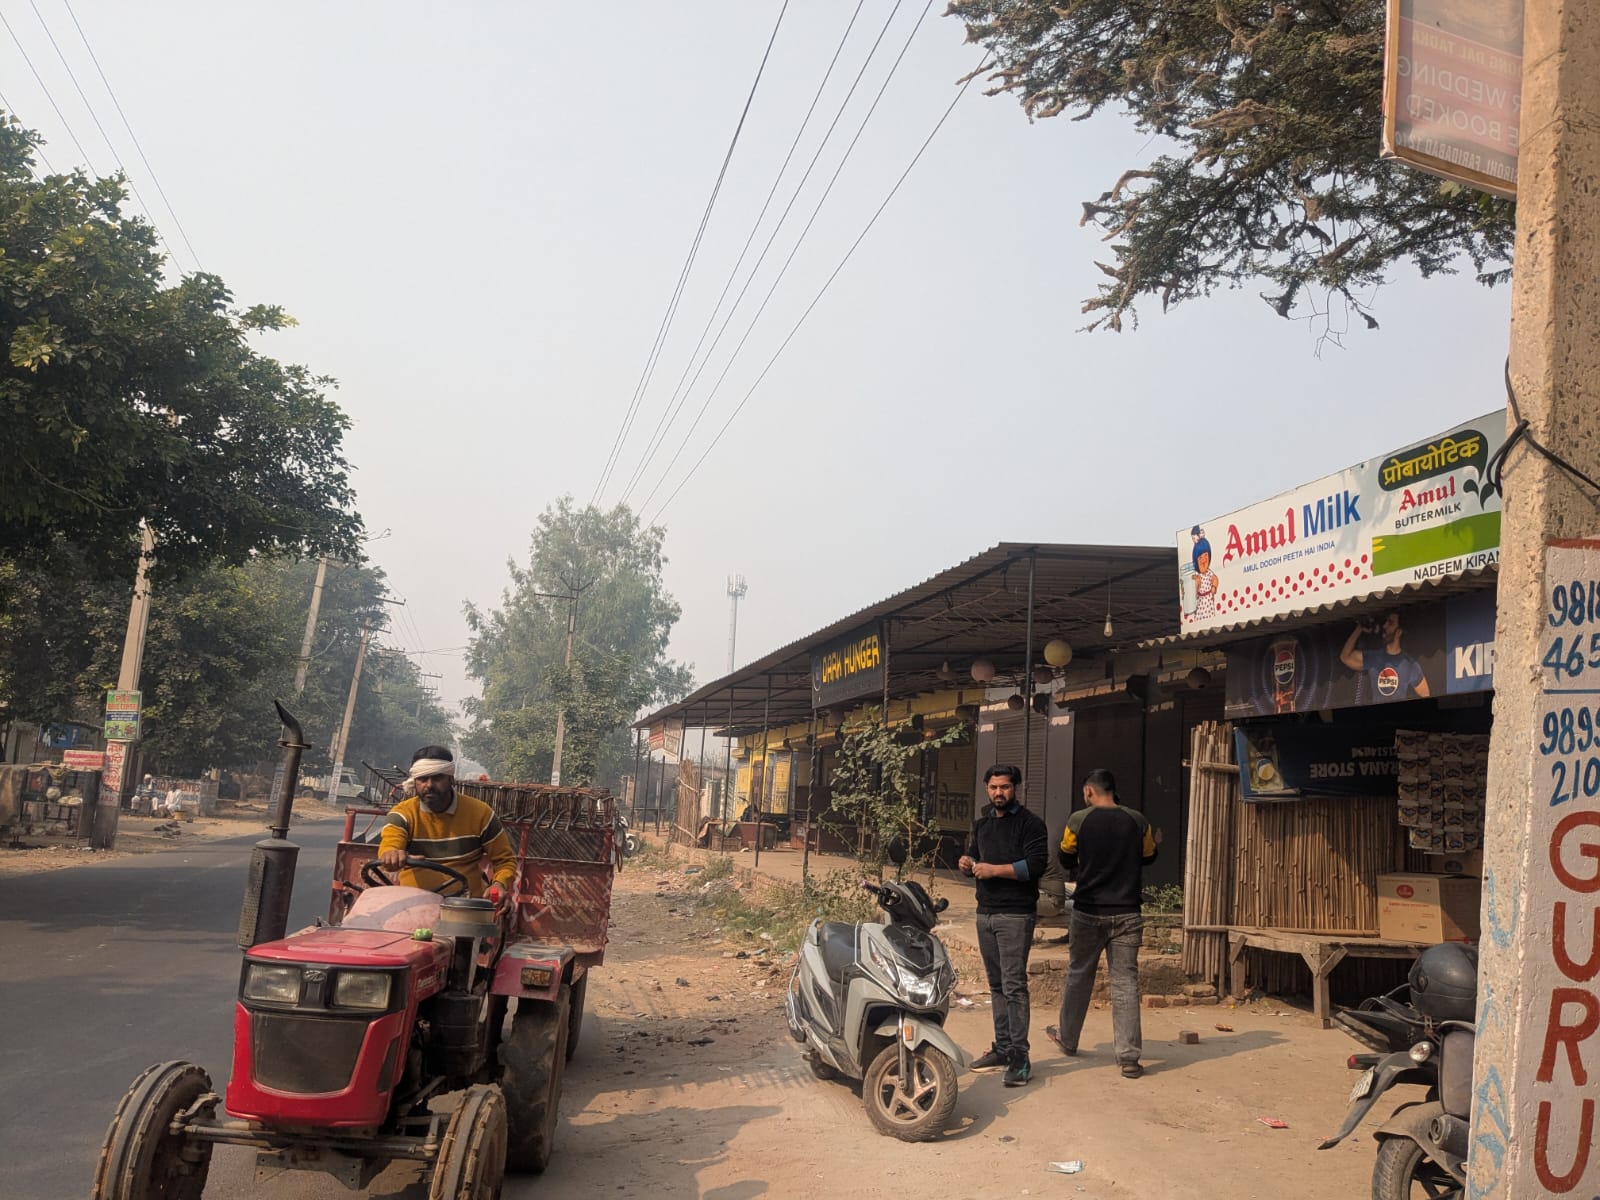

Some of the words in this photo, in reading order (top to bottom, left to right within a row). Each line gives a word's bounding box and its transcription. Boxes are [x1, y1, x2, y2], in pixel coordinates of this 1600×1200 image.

[1382, 436, 1480, 486] प्रोबायोटिक
[1398, 475, 1456, 513] Amul
[1222, 507, 1296, 568] Amul
[1303, 489, 1361, 538] Milk
[1395, 502, 1461, 529] BUTTERMILK
[1243, 562, 1259, 573] AMUL
[1259, 556, 1282, 568] DOODH
[1282, 550, 1303, 563] PEETA
[1304, 546, 1315, 556] HAI
[1317, 540, 1335, 553] INDIA
[1414, 560, 1462, 580] NADEEM
[1548, 580, 1600, 627] 981
[822, 649, 842, 685] DARK
[844, 634, 880, 679] HUNGER
[1275, 662, 1294, 671] PEPSI
[1310, 762, 1355, 778] STORE
